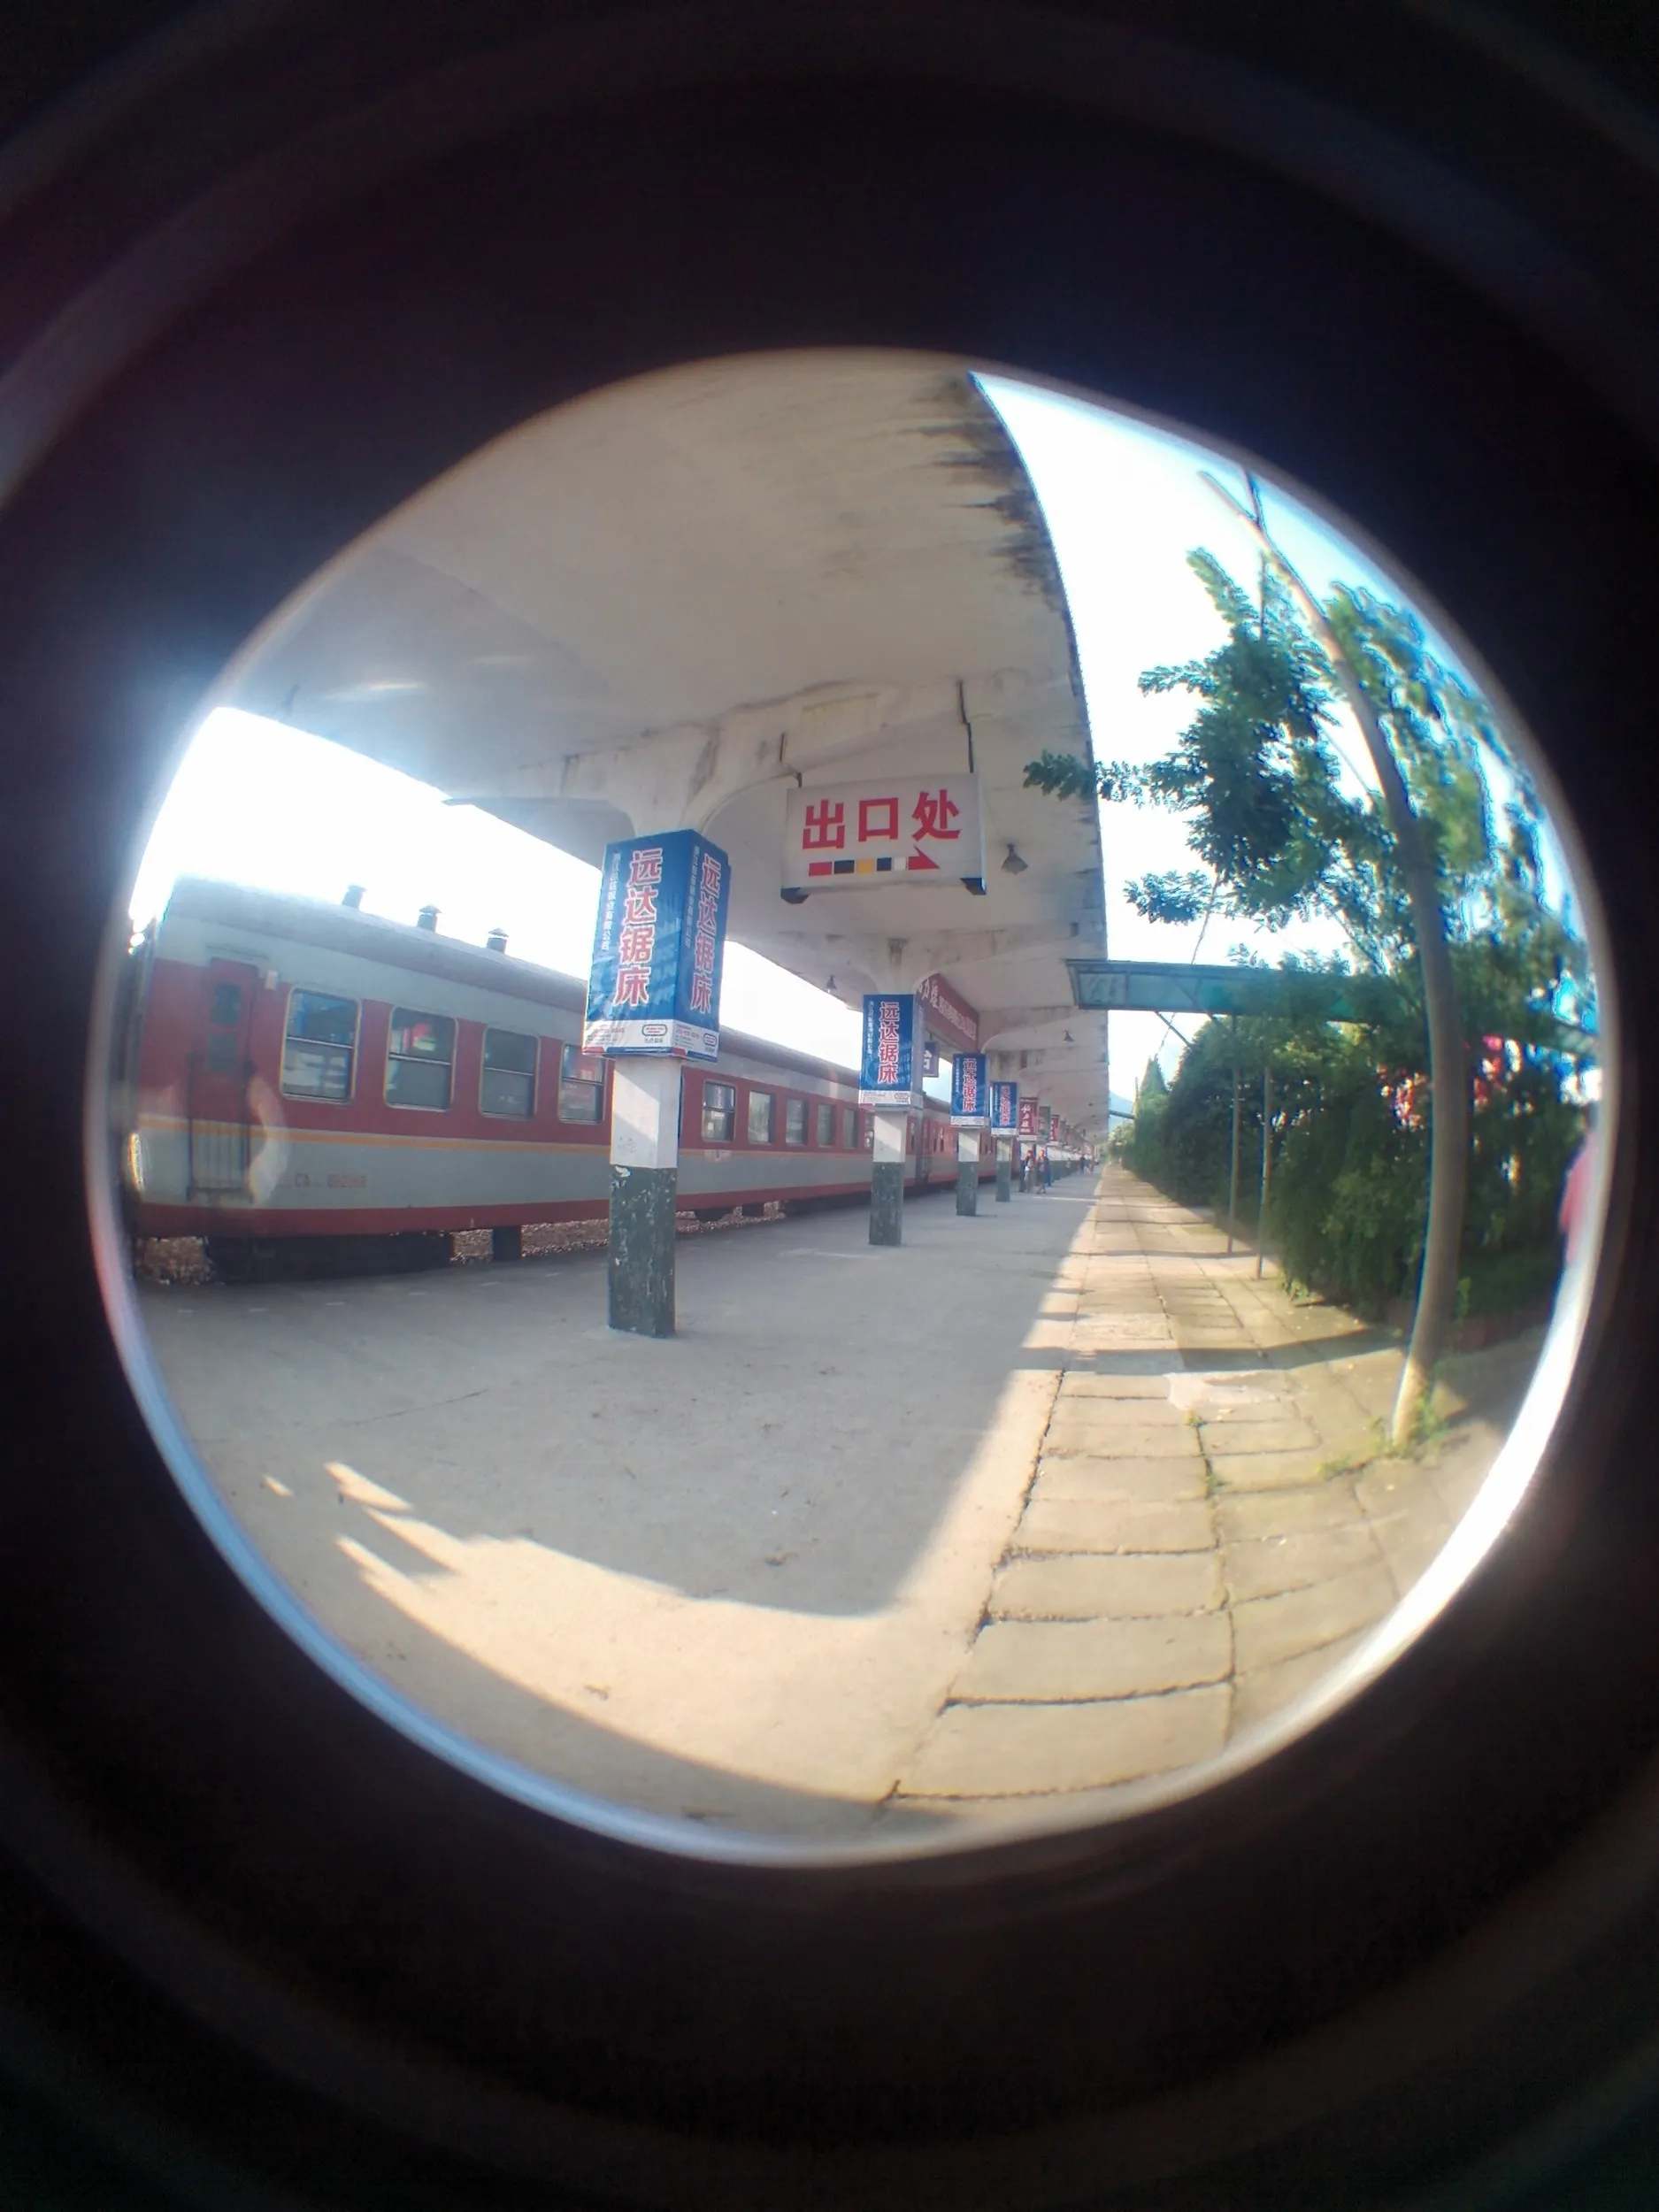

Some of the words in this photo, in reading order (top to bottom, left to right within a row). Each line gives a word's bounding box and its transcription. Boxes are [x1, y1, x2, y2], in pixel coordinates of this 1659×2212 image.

[803, 789, 961, 849] 出口处
[613, 848, 664, 1007] 远达锯床
[690, 853, 721, 1014] 远达锯床
[878, 1002, 900, 1085] 远达锯床
[963, 1058, 977, 1112] 远达锯床
